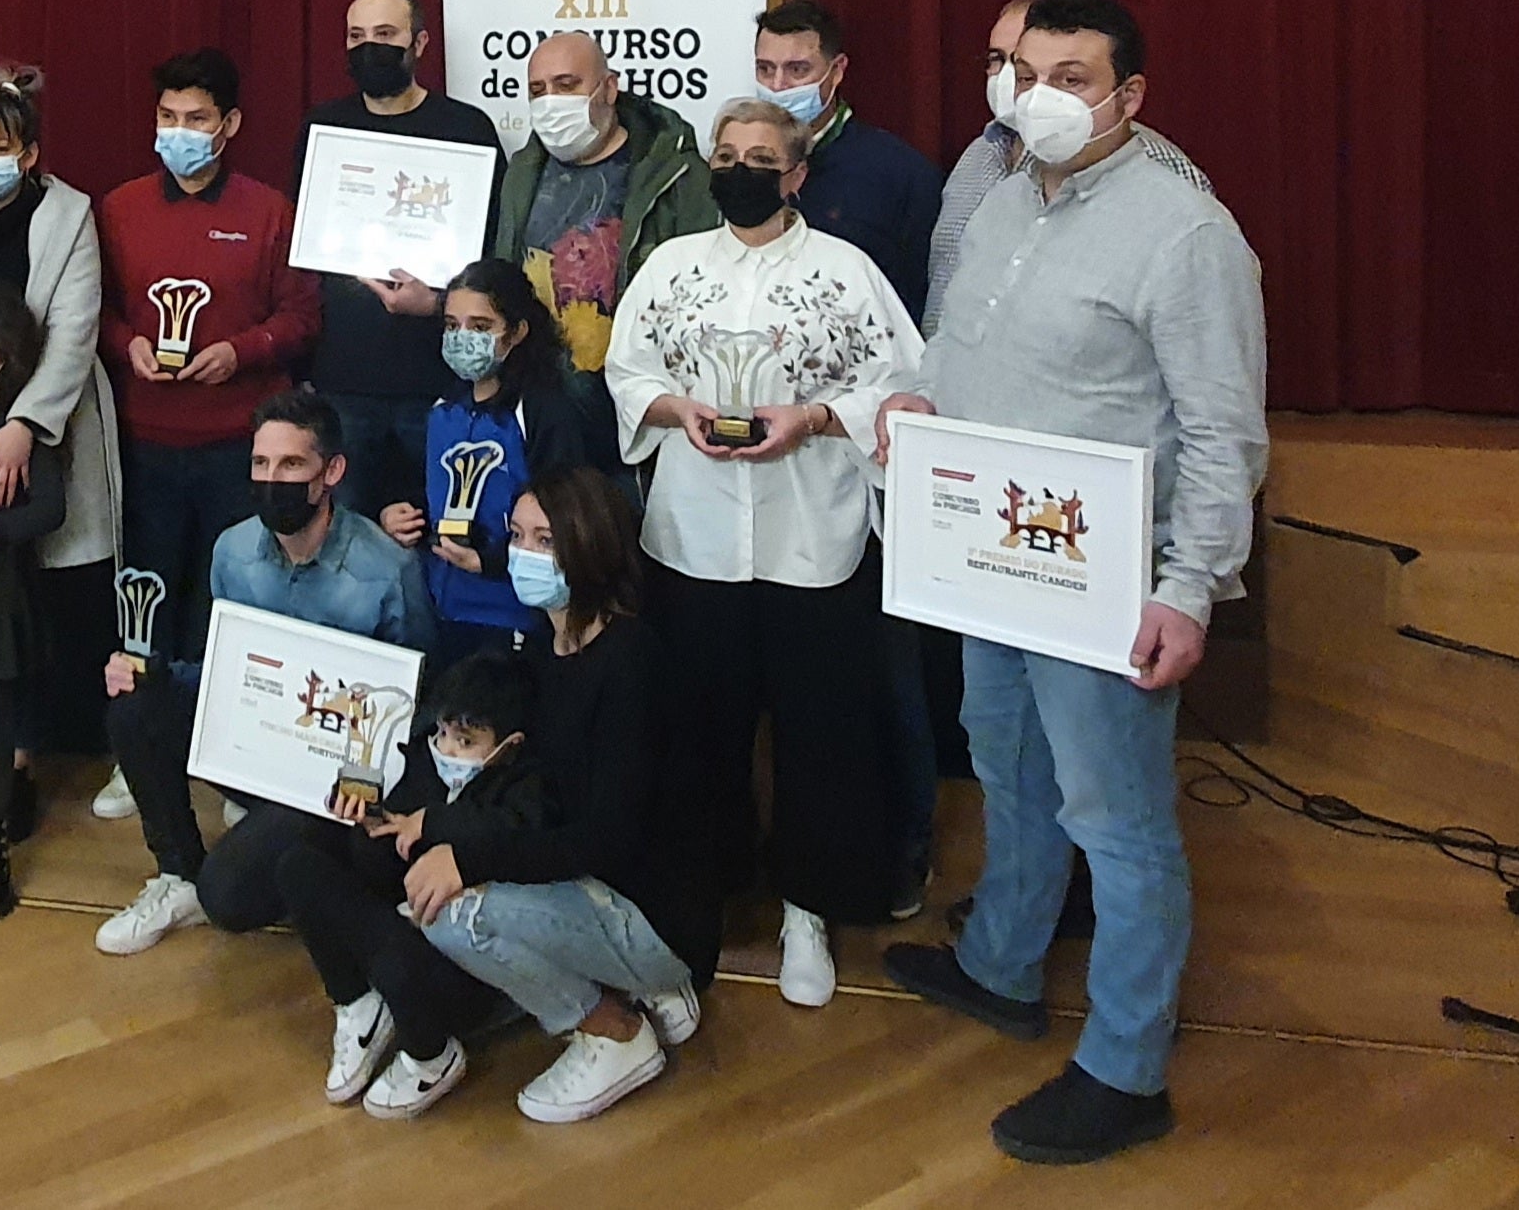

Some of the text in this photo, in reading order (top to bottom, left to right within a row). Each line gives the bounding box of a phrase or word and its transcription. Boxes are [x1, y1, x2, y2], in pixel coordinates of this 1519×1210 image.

[482, 28, 701, 60] COURSO
[481, 68, 520, 98] de
[499, 112, 524, 130] de
